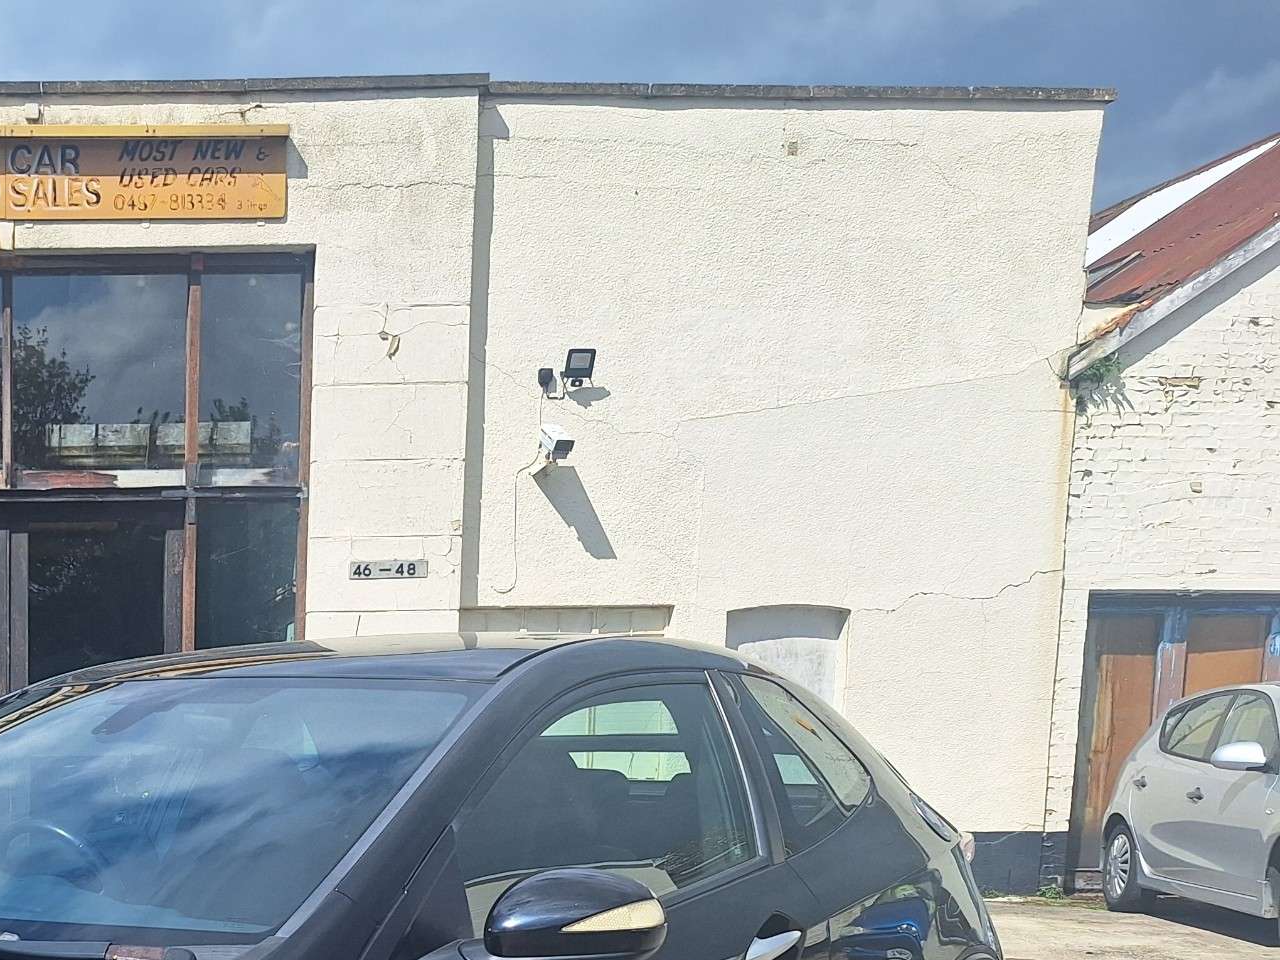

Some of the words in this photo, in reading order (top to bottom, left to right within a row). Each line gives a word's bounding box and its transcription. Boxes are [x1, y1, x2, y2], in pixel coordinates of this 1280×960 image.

[10, 143, 81, 175] CAR
[118, 140, 182, 162] MOST
[192, 140, 247, 162] NEW
[118, 167, 178, 189] USED
[187, 166, 242, 188] CARS
[10, 177, 101, 208] SALES
